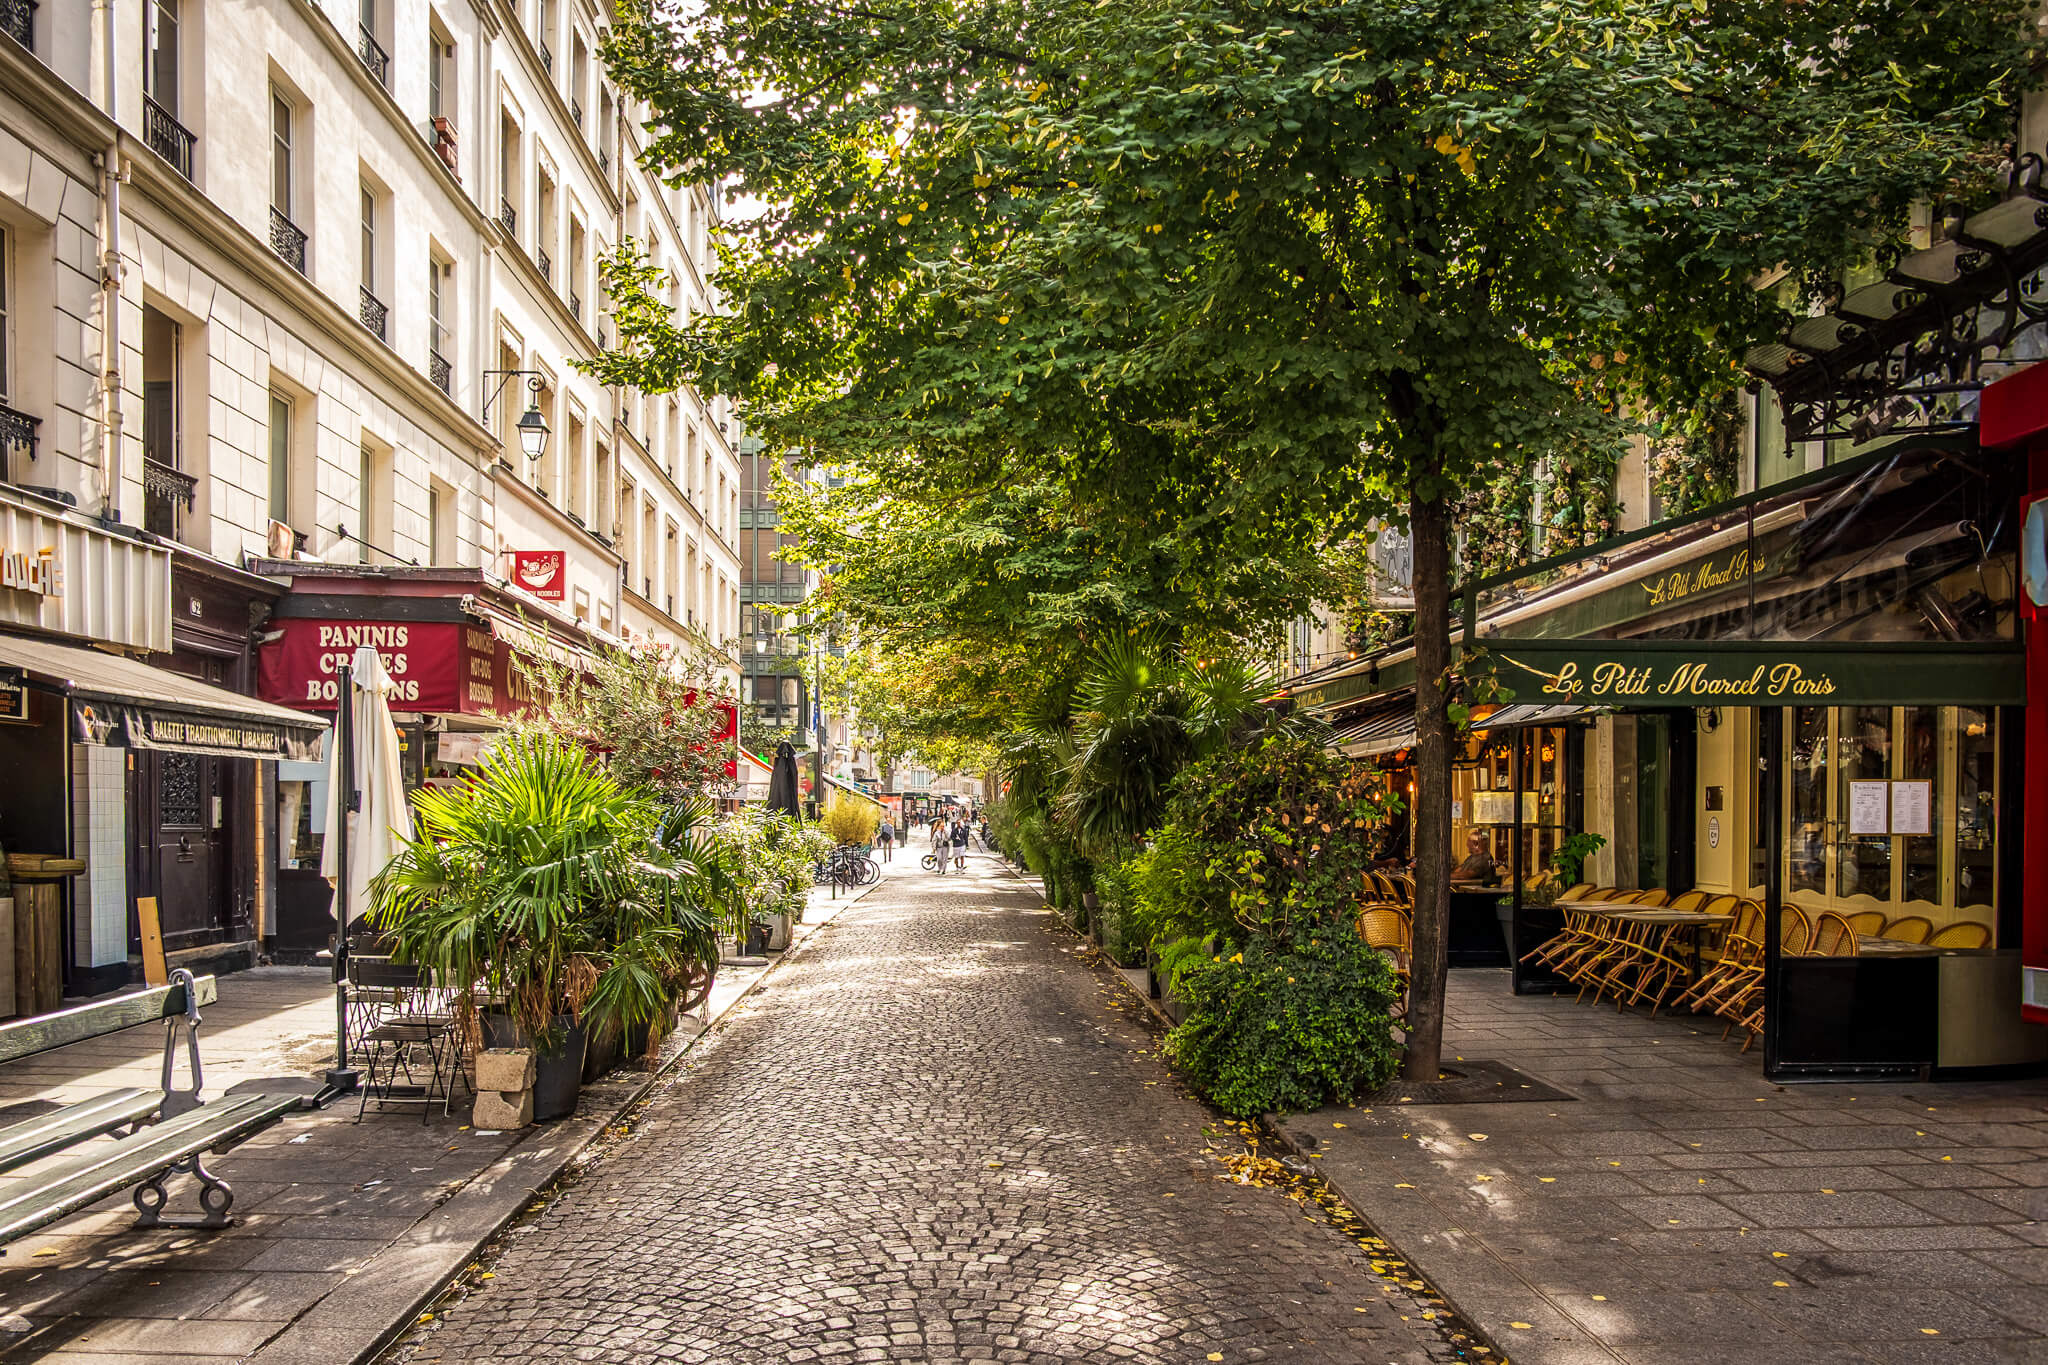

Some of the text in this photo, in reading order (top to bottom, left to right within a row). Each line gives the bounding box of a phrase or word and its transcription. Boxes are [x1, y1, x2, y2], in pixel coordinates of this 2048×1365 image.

[1650, 578, 1667, 606] Le
[1668, 572, 1691, 600] Petit
[1691, 554, 1737, 592] Marcel
[191, 600, 201, 615] 62
[319, 625, 409, 648] PANINIS
[466, 628, 495, 656] SANDWICHES
[319, 652, 408, 675] CRES
[470, 655, 492, 681] HOT-DOG
[1542, 661, 1837, 696] Le Petit Marcel Paris
[468, 681, 494, 706] BOISSONS
[152, 719, 185, 740] GALETTE
[184, 723, 241, 746] TRADITIONNELLE
[241, 730, 275, 749] LIBANAISE
